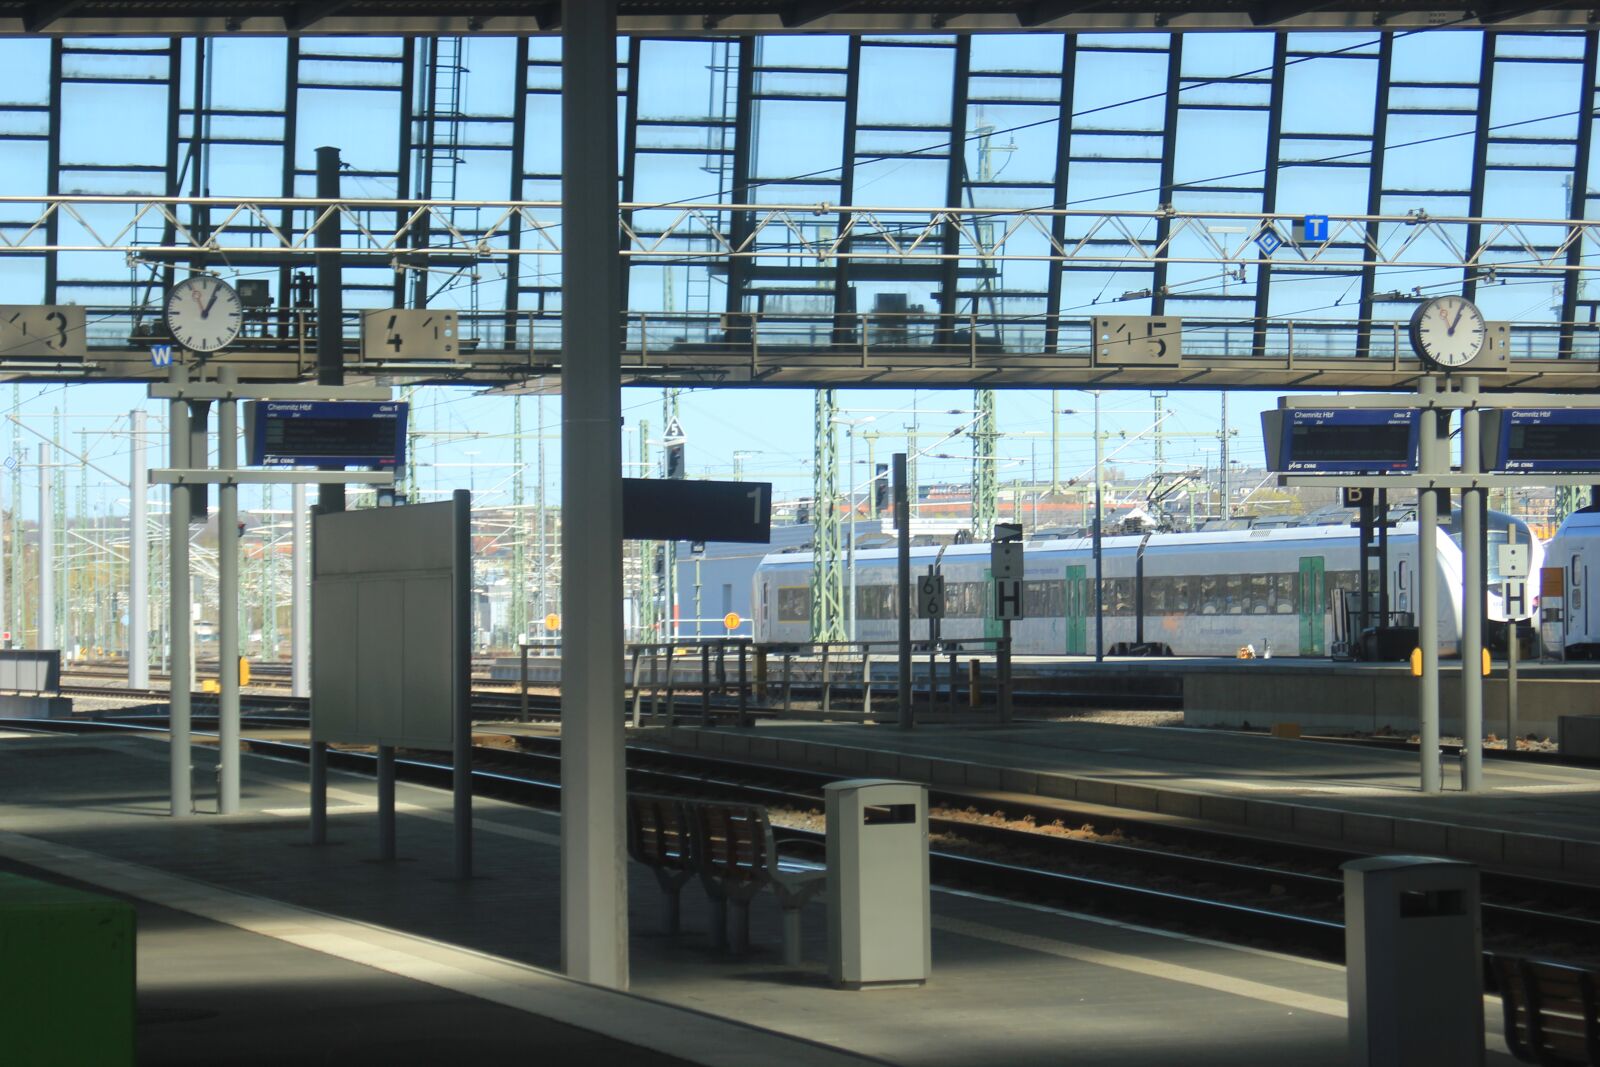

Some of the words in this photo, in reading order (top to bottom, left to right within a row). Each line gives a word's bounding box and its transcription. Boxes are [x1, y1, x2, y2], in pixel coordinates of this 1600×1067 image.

[1309, 218, 1324, 237] T
[46, 312, 67, 349] 3
[386, 315, 403, 353] 4
[1147, 322, 1167, 358] 5
[151, 346, 171, 365] W
[267, 403, 299, 411] Chemnitz
[300, 403, 312, 411] Hbf
[1294, 411, 1323, 419] Chemnitz
[1323, 411, 1335, 419] Hbf
[671, 423, 679, 436] 5
[746, 487, 761, 524] 1
[922, 577, 942, 595] 61
[927, 597, 938, 614] 6
[999, 581, 1020, 616] H
[1506, 582, 1524, 615] H
